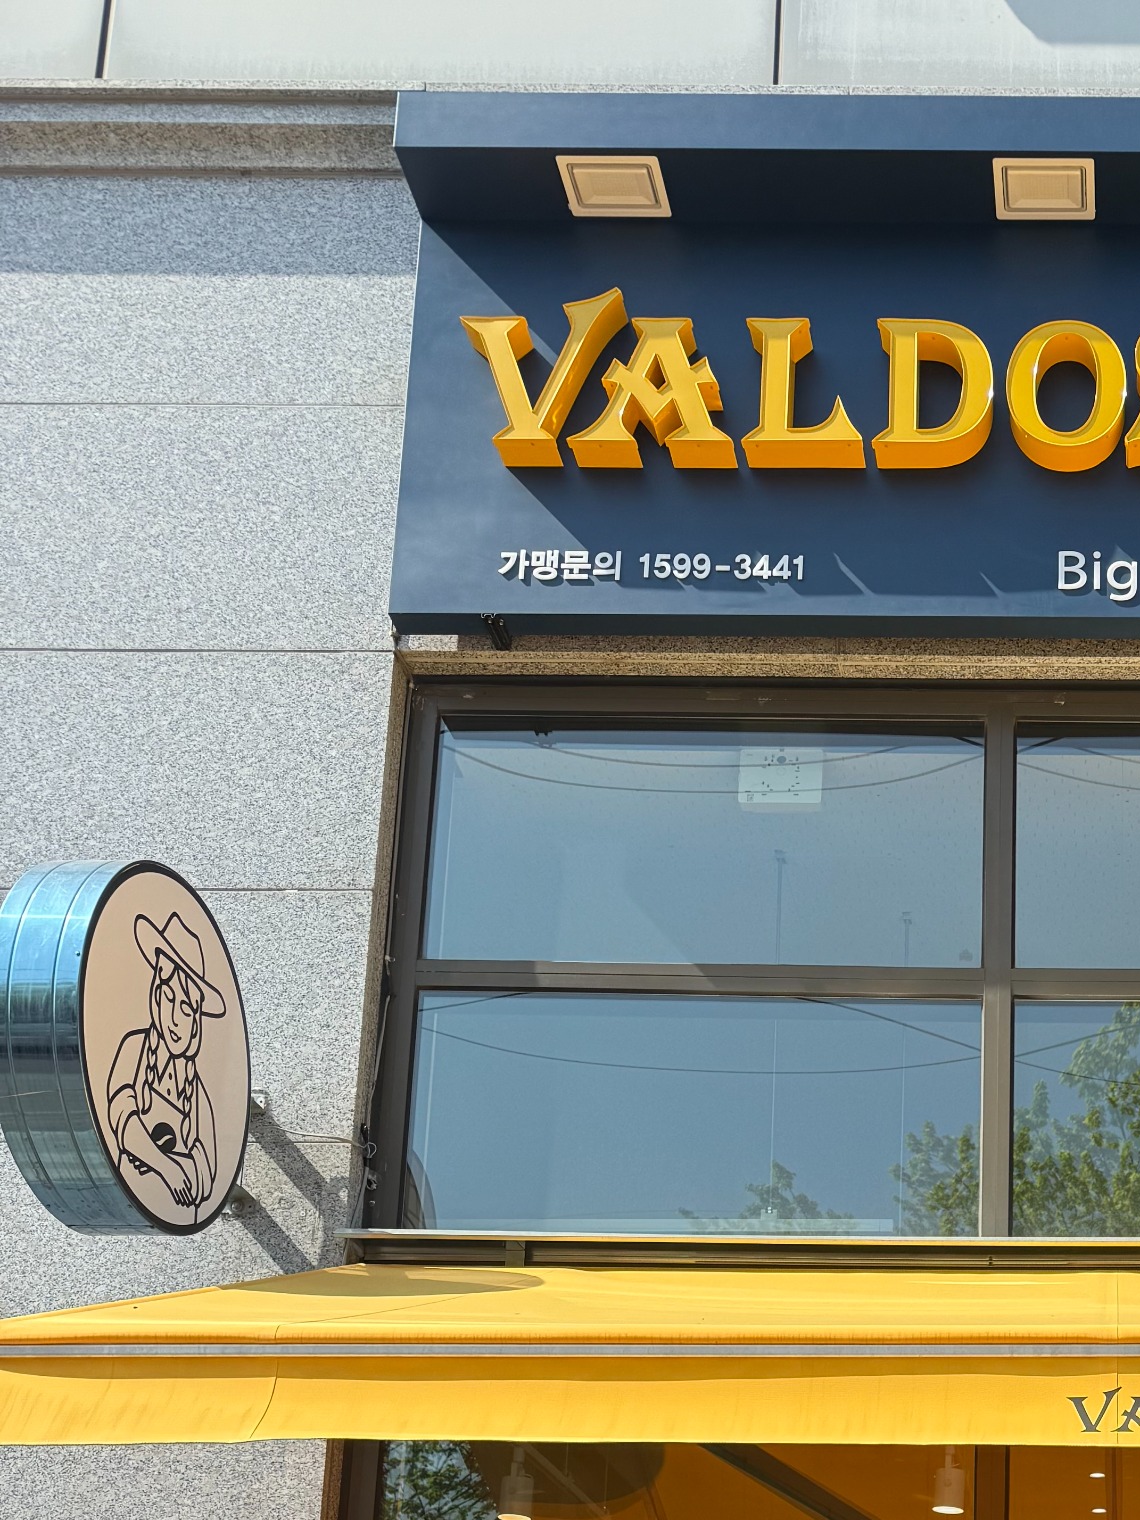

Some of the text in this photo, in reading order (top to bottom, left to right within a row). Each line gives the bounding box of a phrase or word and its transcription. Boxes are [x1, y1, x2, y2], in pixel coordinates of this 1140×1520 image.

[497, 549, 804, 581] 가맹문의 1599-3441
[1057, 550, 1139, 601] Big
